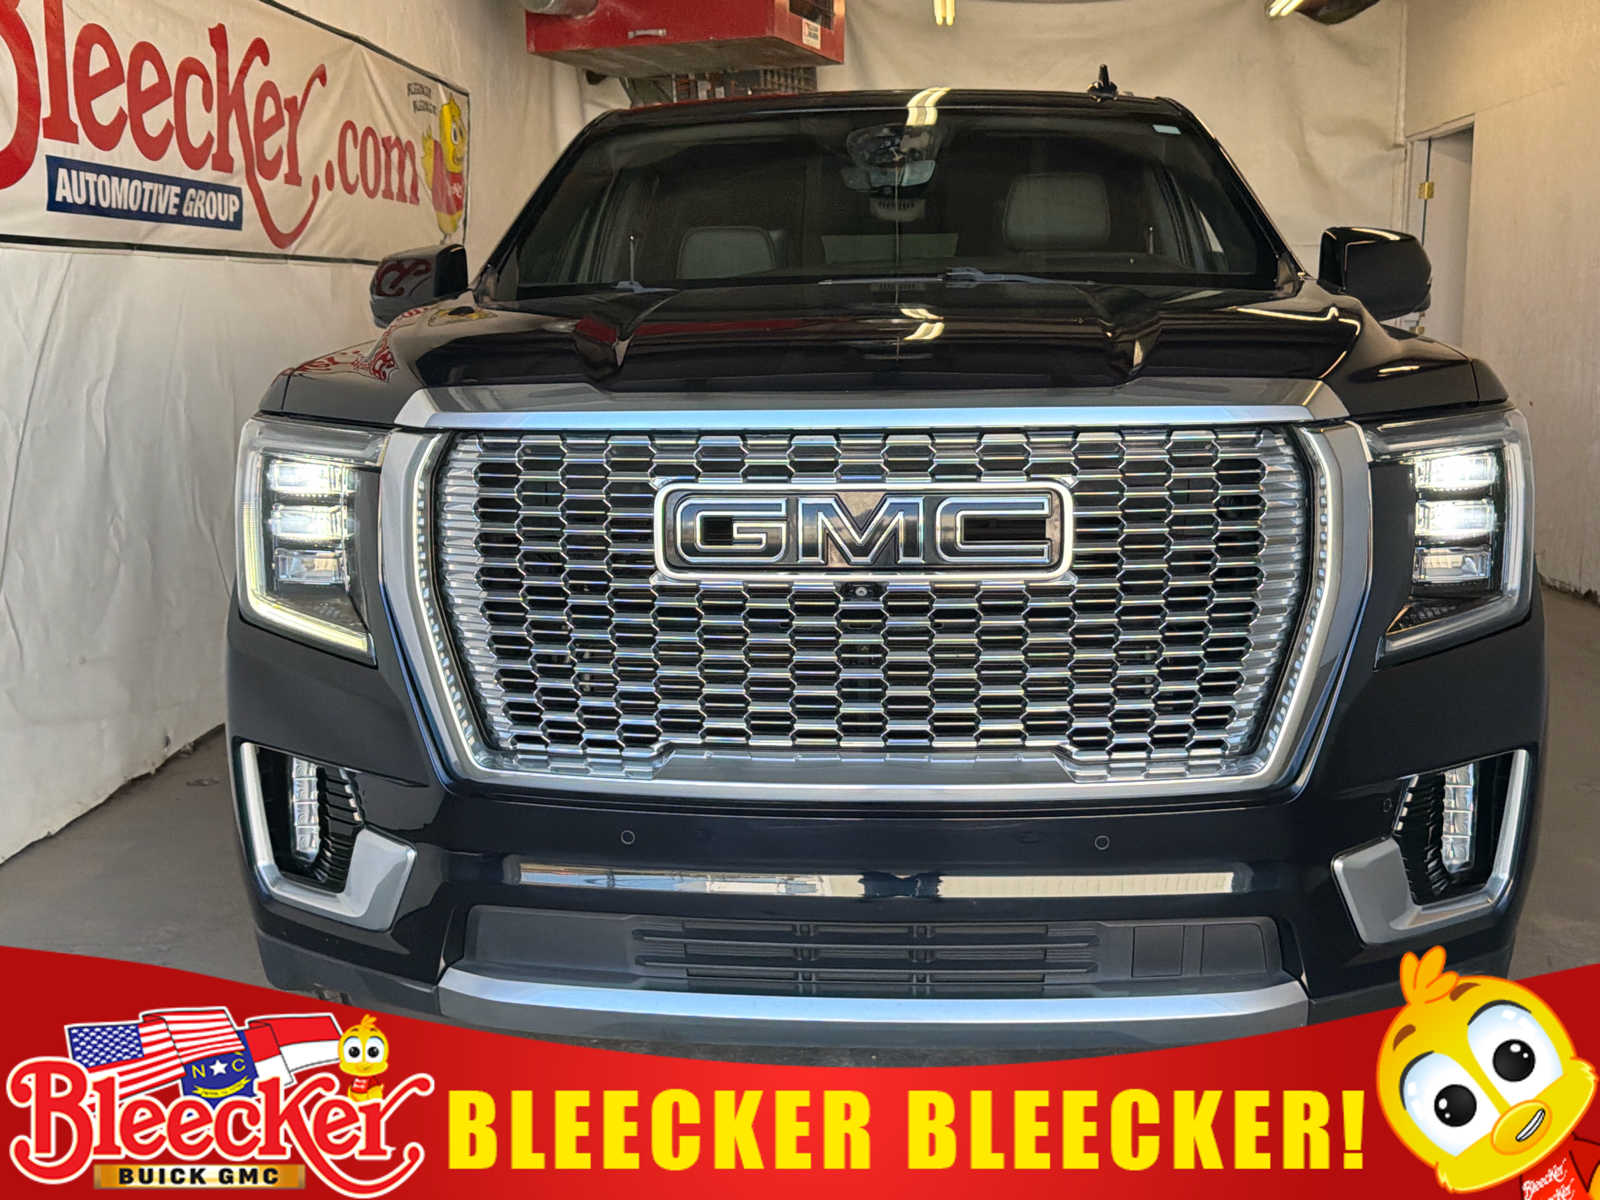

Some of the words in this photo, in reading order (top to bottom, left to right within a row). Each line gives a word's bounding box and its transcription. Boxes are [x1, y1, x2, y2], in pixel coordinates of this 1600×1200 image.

[55, 168, 181, 215] AUTOMOTIVE
[183, 188, 240, 222] GROUP
[677, 496, 1050, 563] GMC
